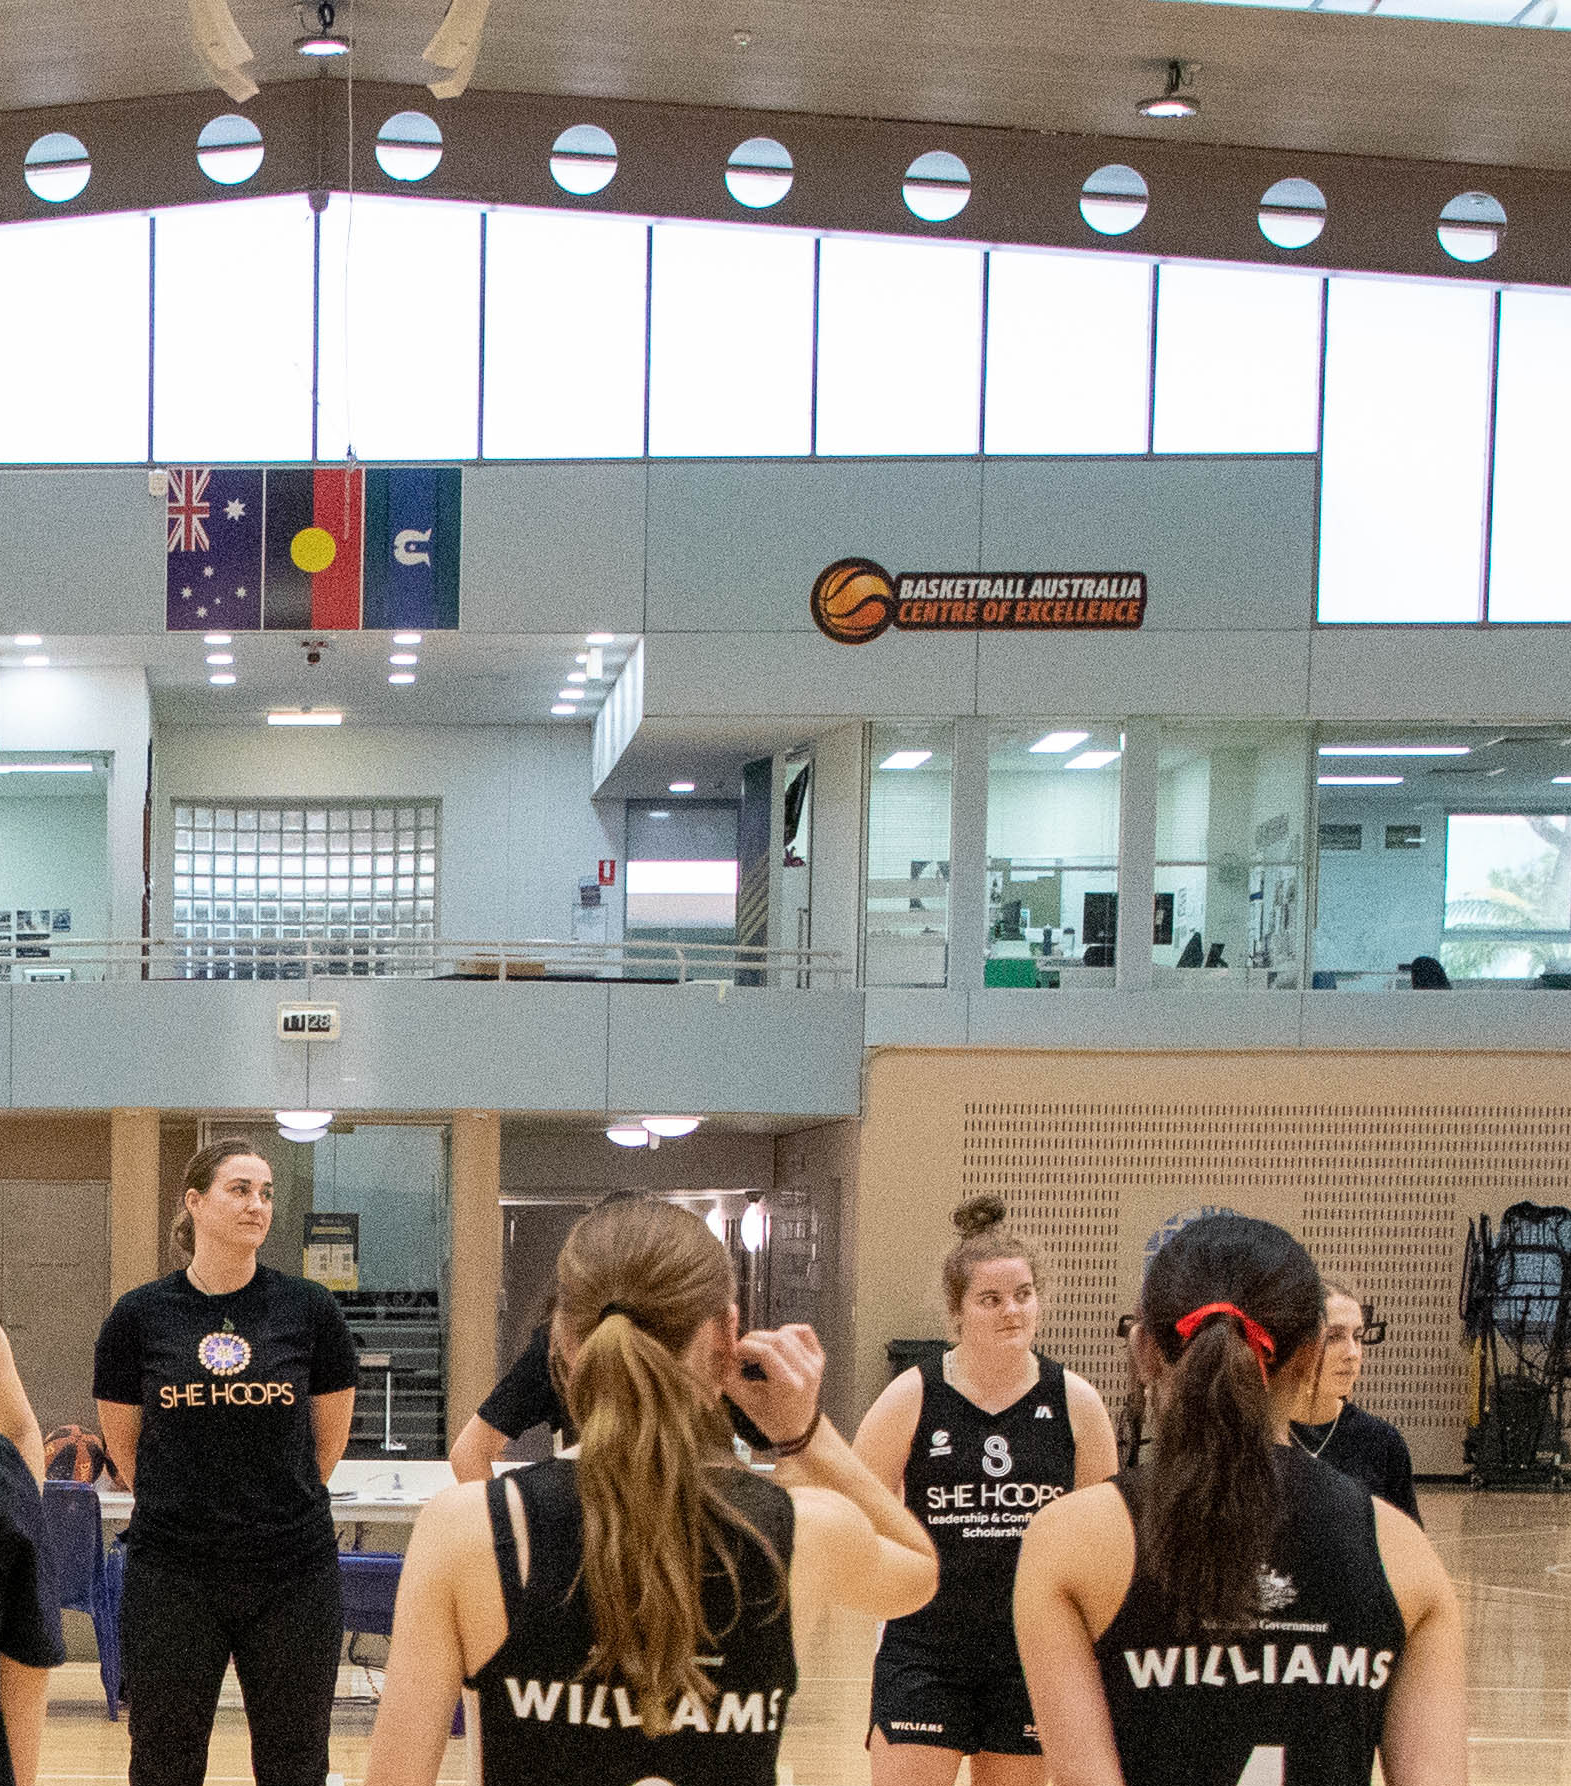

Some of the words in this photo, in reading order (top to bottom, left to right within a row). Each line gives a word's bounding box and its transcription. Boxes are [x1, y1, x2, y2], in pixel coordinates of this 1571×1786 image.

[899, 577, 1023, 600] BASKETBALL
[1028, 577, 1143, 600] AUSTRALIA
[898, 600, 978, 623] CENTRE
[982, 600, 1011, 623] OF
[1014, 600, 1140, 623] EXCELLENCE
[159, 1383, 206, 1409] SHE
[211, 1382, 295, 1406] HOOPS
[926, 1483, 975, 1509] SHE
[927, 1511, 989, 1525] Leadership
[990, 1512, 1001, 1524] &
[962, 1526, 1023, 1538] Scholarshi
[1122, 1643, 1395, 1690] WILLIAMS
[890, 1721, 944, 1733] WILLIAMS
